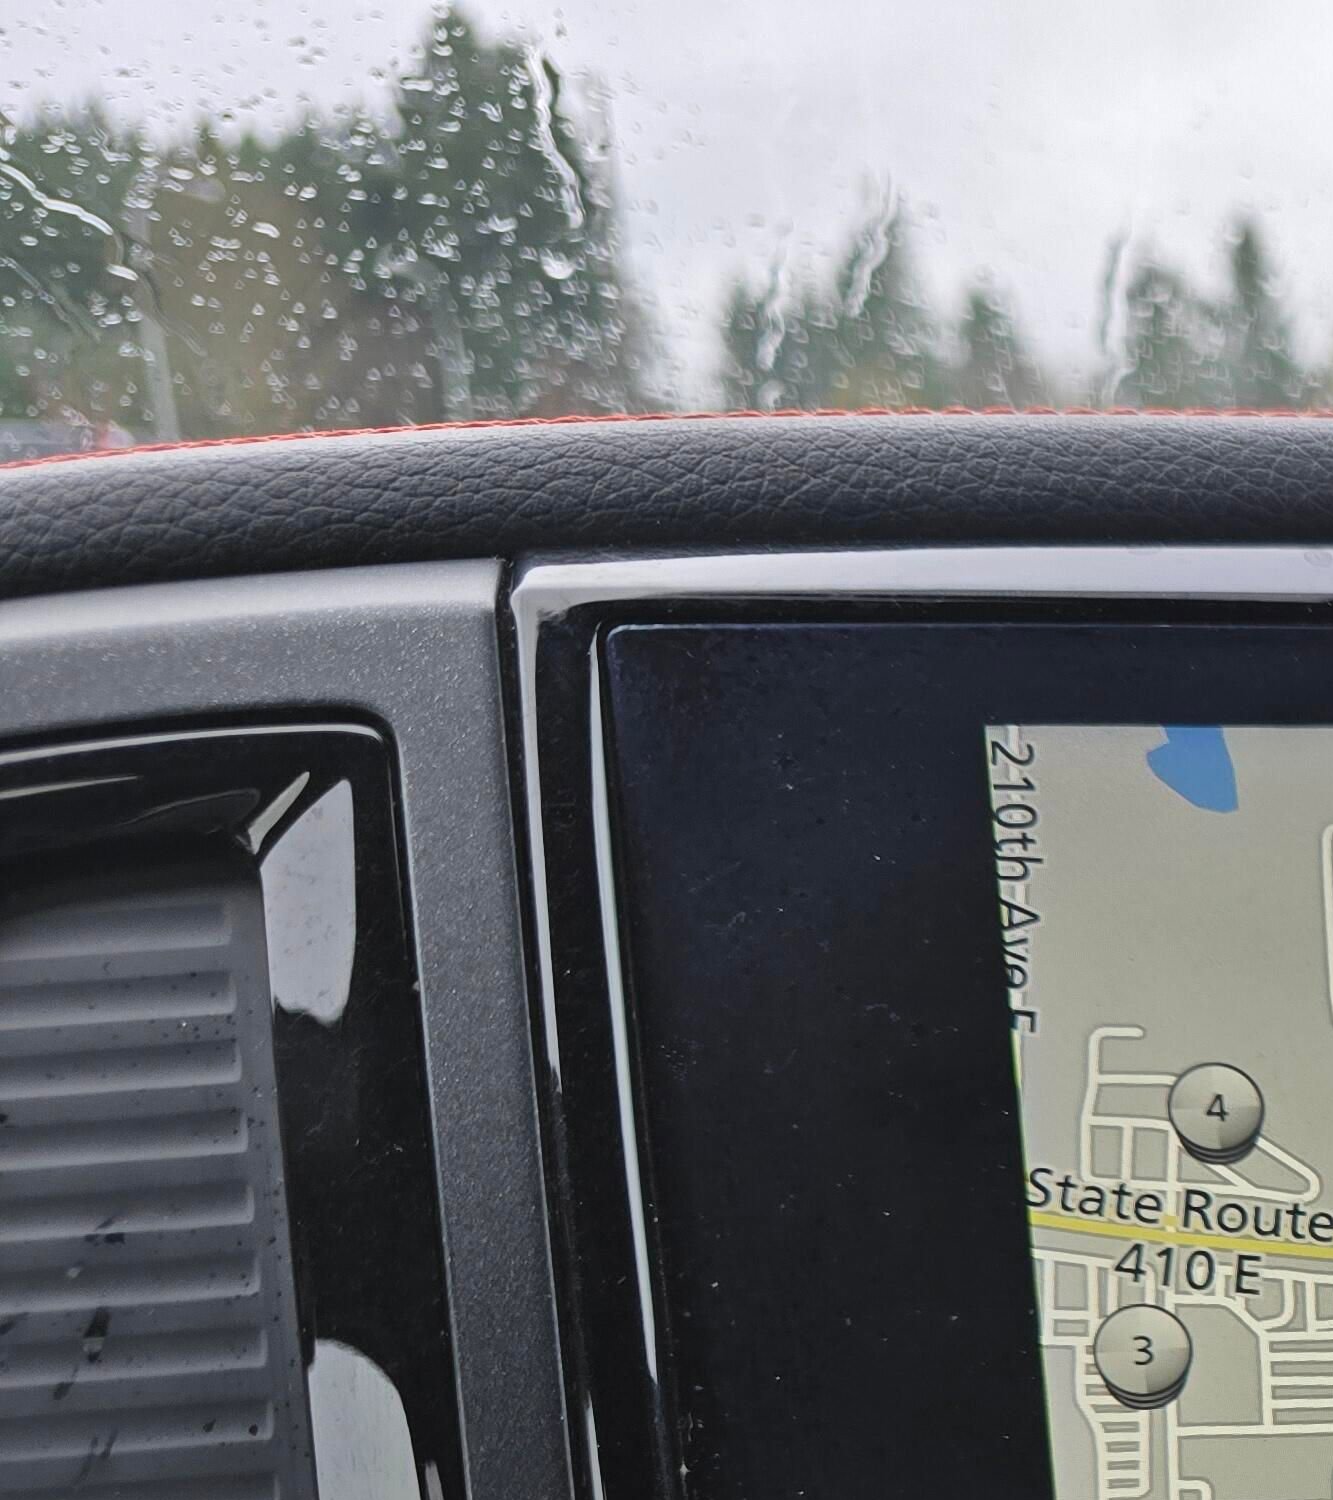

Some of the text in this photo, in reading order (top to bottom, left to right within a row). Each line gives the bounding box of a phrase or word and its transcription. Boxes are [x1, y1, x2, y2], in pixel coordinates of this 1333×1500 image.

[990, 740, 1043, 881] 210th
[1207, 1094, 1228, 1121] 4
[1029, 1167, 1162, 1223] State
[1114, 1243, 1262, 1293] 410 E
[1134, 1335, 1153, 1365] 3
